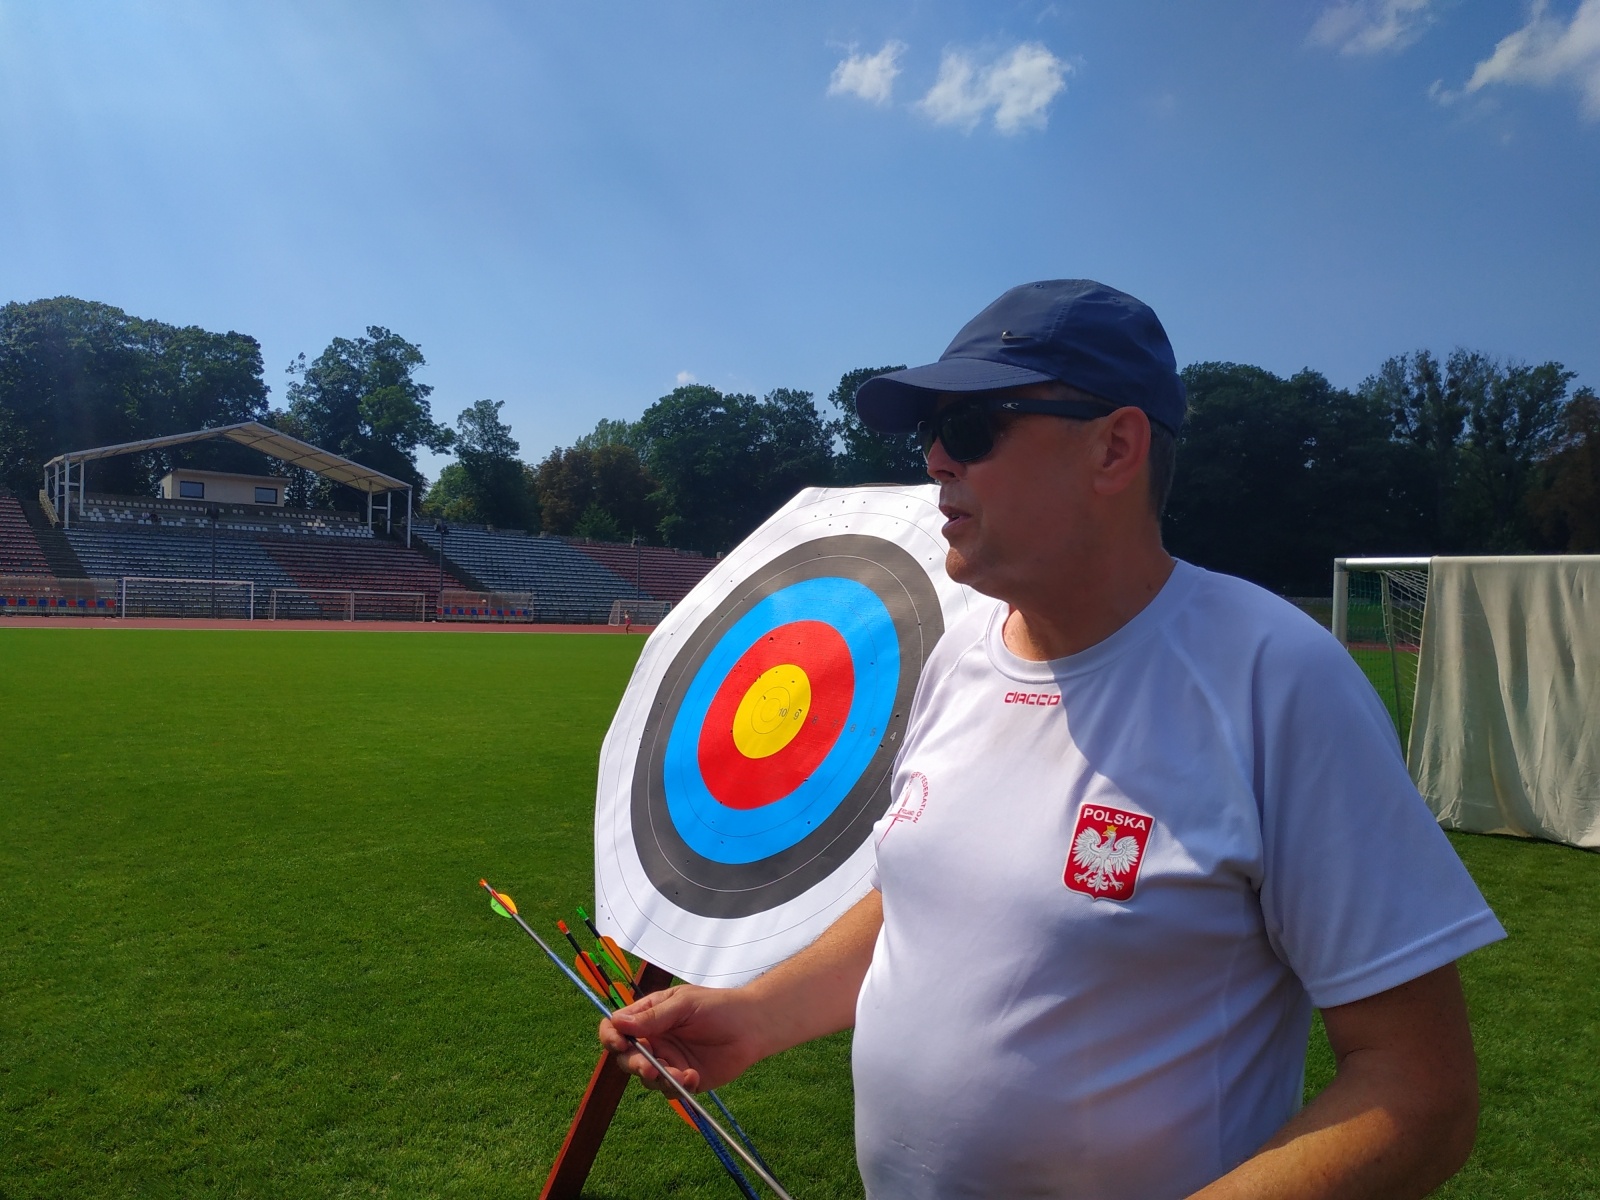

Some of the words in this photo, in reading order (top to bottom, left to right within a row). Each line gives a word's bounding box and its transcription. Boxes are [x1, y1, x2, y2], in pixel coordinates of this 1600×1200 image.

[778, 708, 788, 718] 10
[889, 731, 897, 742] 4
[912, 775, 929, 823] FEDERATION
[1083, 808, 1146, 831] POLSKA
